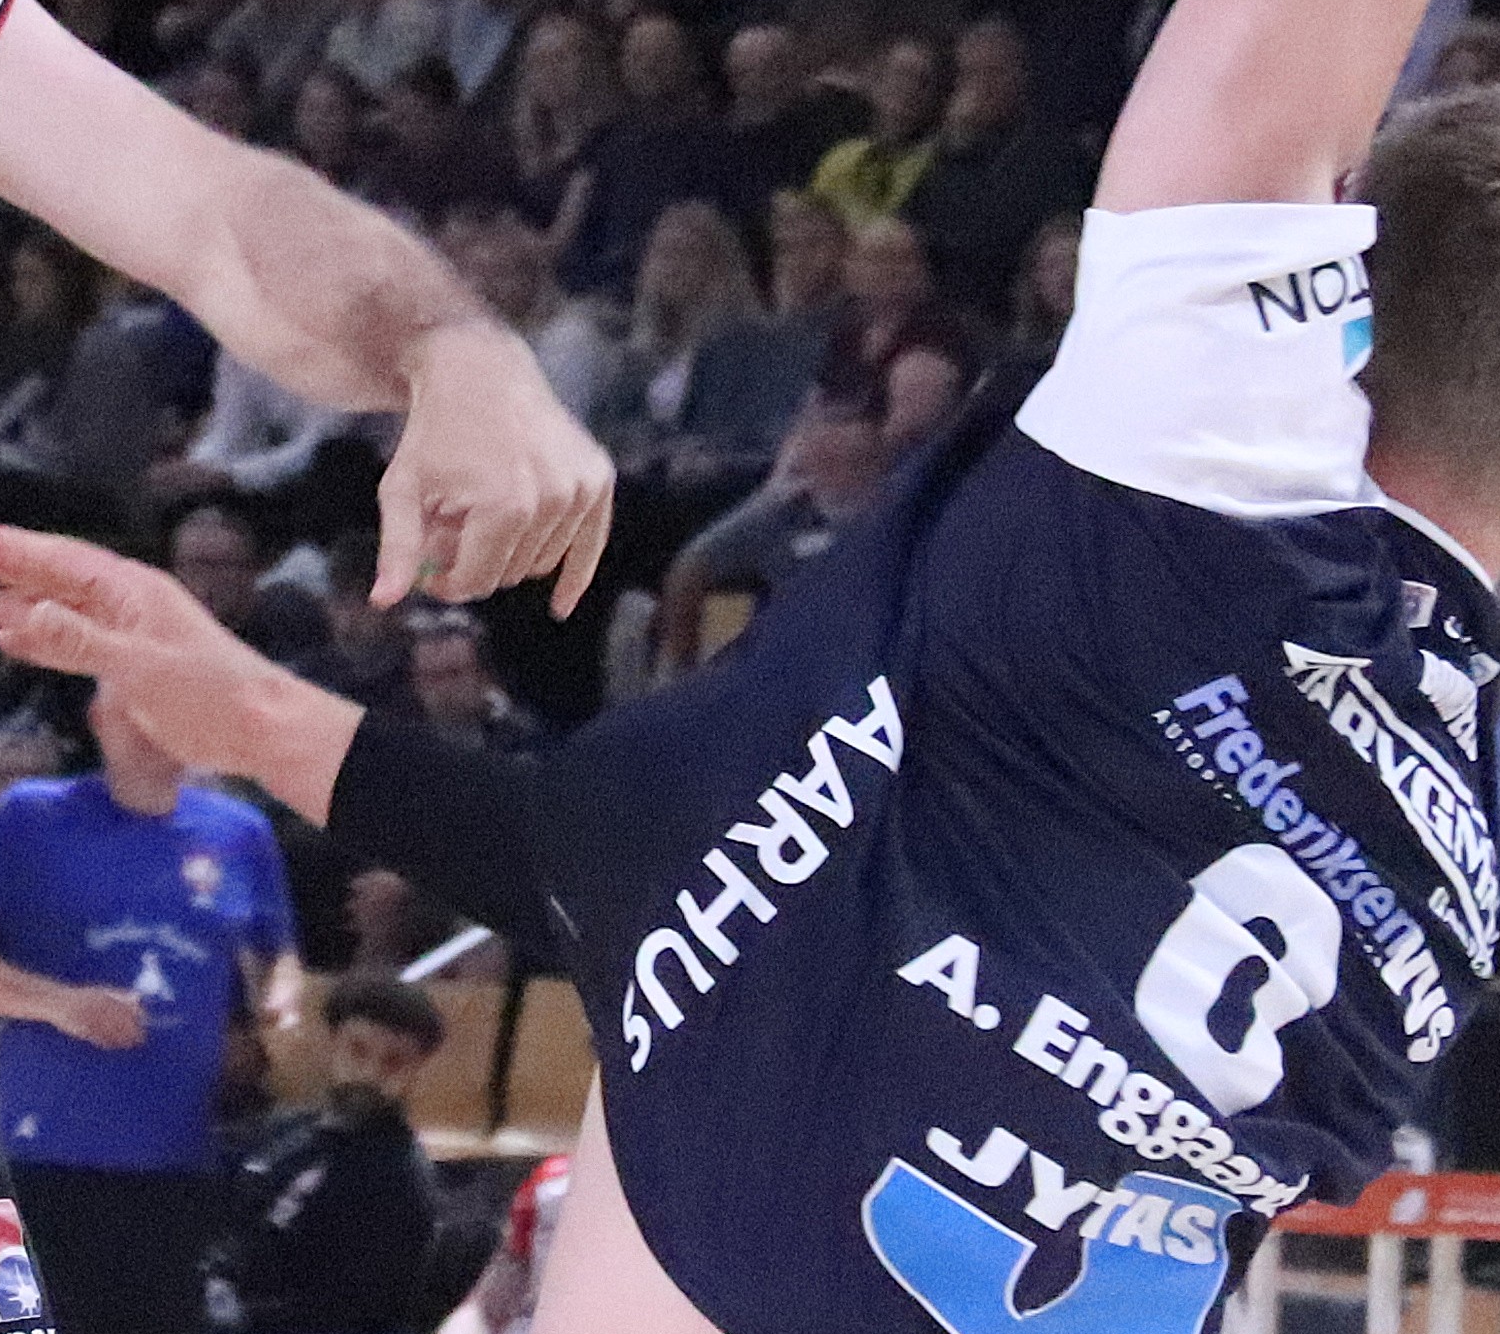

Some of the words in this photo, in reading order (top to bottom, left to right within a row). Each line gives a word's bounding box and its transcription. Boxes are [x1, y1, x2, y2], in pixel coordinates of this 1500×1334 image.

[622, 675, 904, 1073] AARHUS
[896, 933, 1001, 1031] A.
[925, 1126, 1219, 1266] JYTAS
